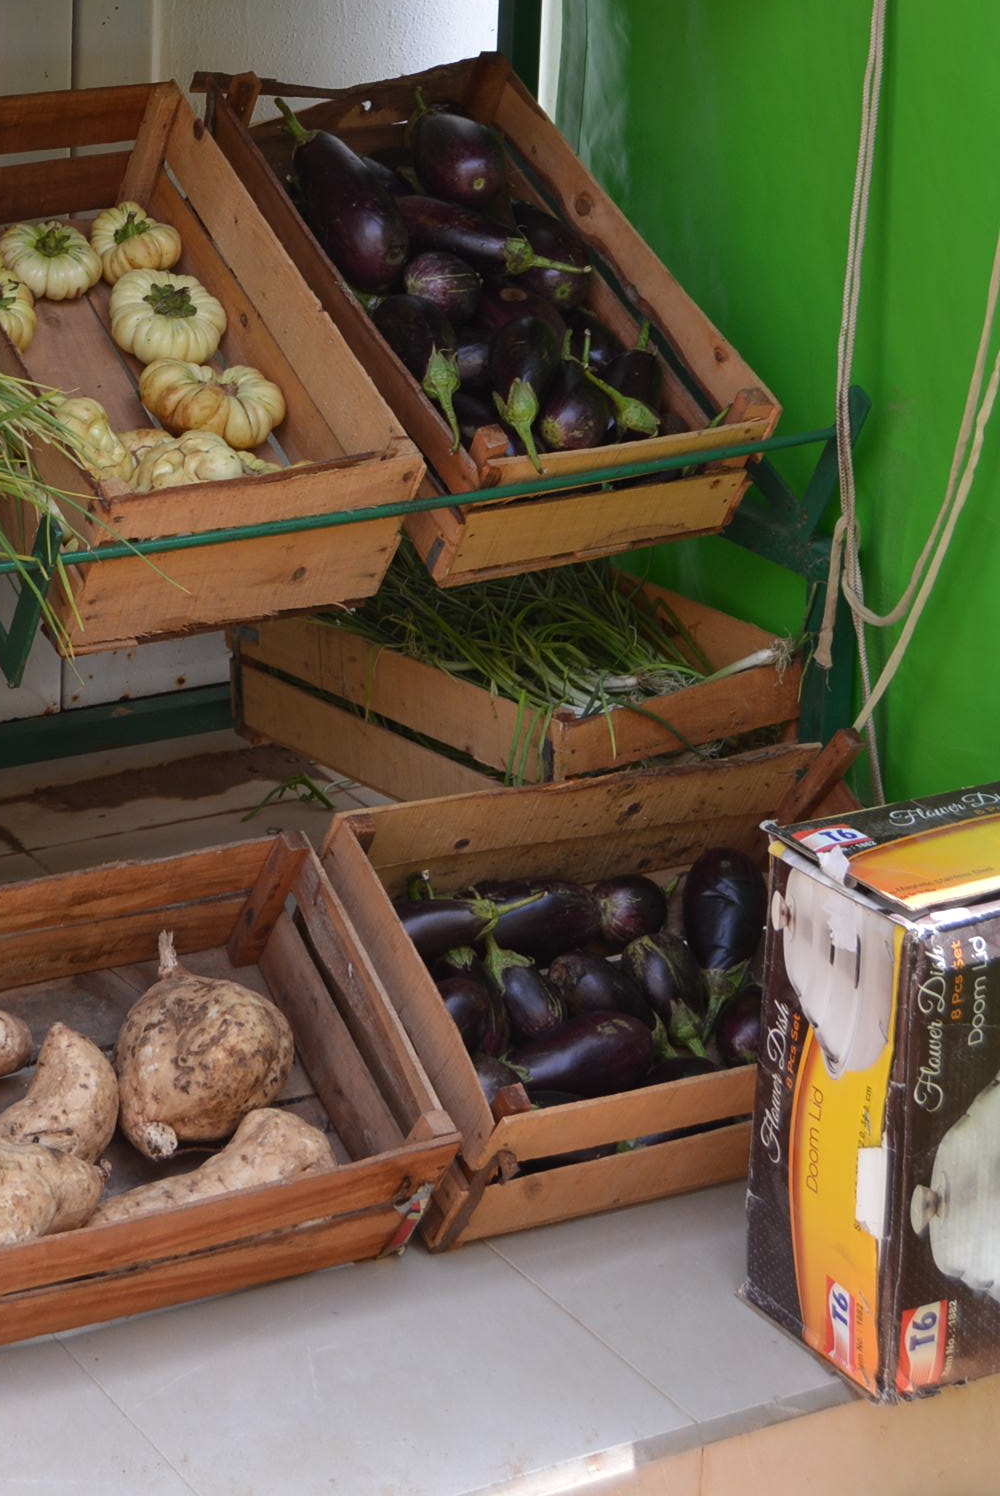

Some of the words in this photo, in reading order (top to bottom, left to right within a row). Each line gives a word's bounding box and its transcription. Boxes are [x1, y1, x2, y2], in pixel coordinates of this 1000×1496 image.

[889, 803, 966, 826] Flower
[819, 829, 857, 842] T6
[951, 939, 965, 971] Set
[968, 936, 988, 971] Lid
[917, 945, 946, 1014] Dish
[951, 975, 964, 1005] Pcs
[790, 1012, 801, 1042] Set
[951, 1009, 962, 1021] 8
[967, 976, 988, 1046] Doom
[766, 999, 789, 1071] Dish
[787, 1046, 797, 1075] Pcs
[914, 1018, 944, 1112] Flower
[786, 1079, 793, 1089] 8
[864, 1086, 873, 1102] cm
[760, 1072, 783, 1164] Flower
[807, 1085, 824, 1122] Lid
[804, 1127, 820, 1195] Doom
[832, 1289, 848, 1327] T6
[947, 1299, 958, 1327] 1882
[909, 1311, 938, 1353] T6
